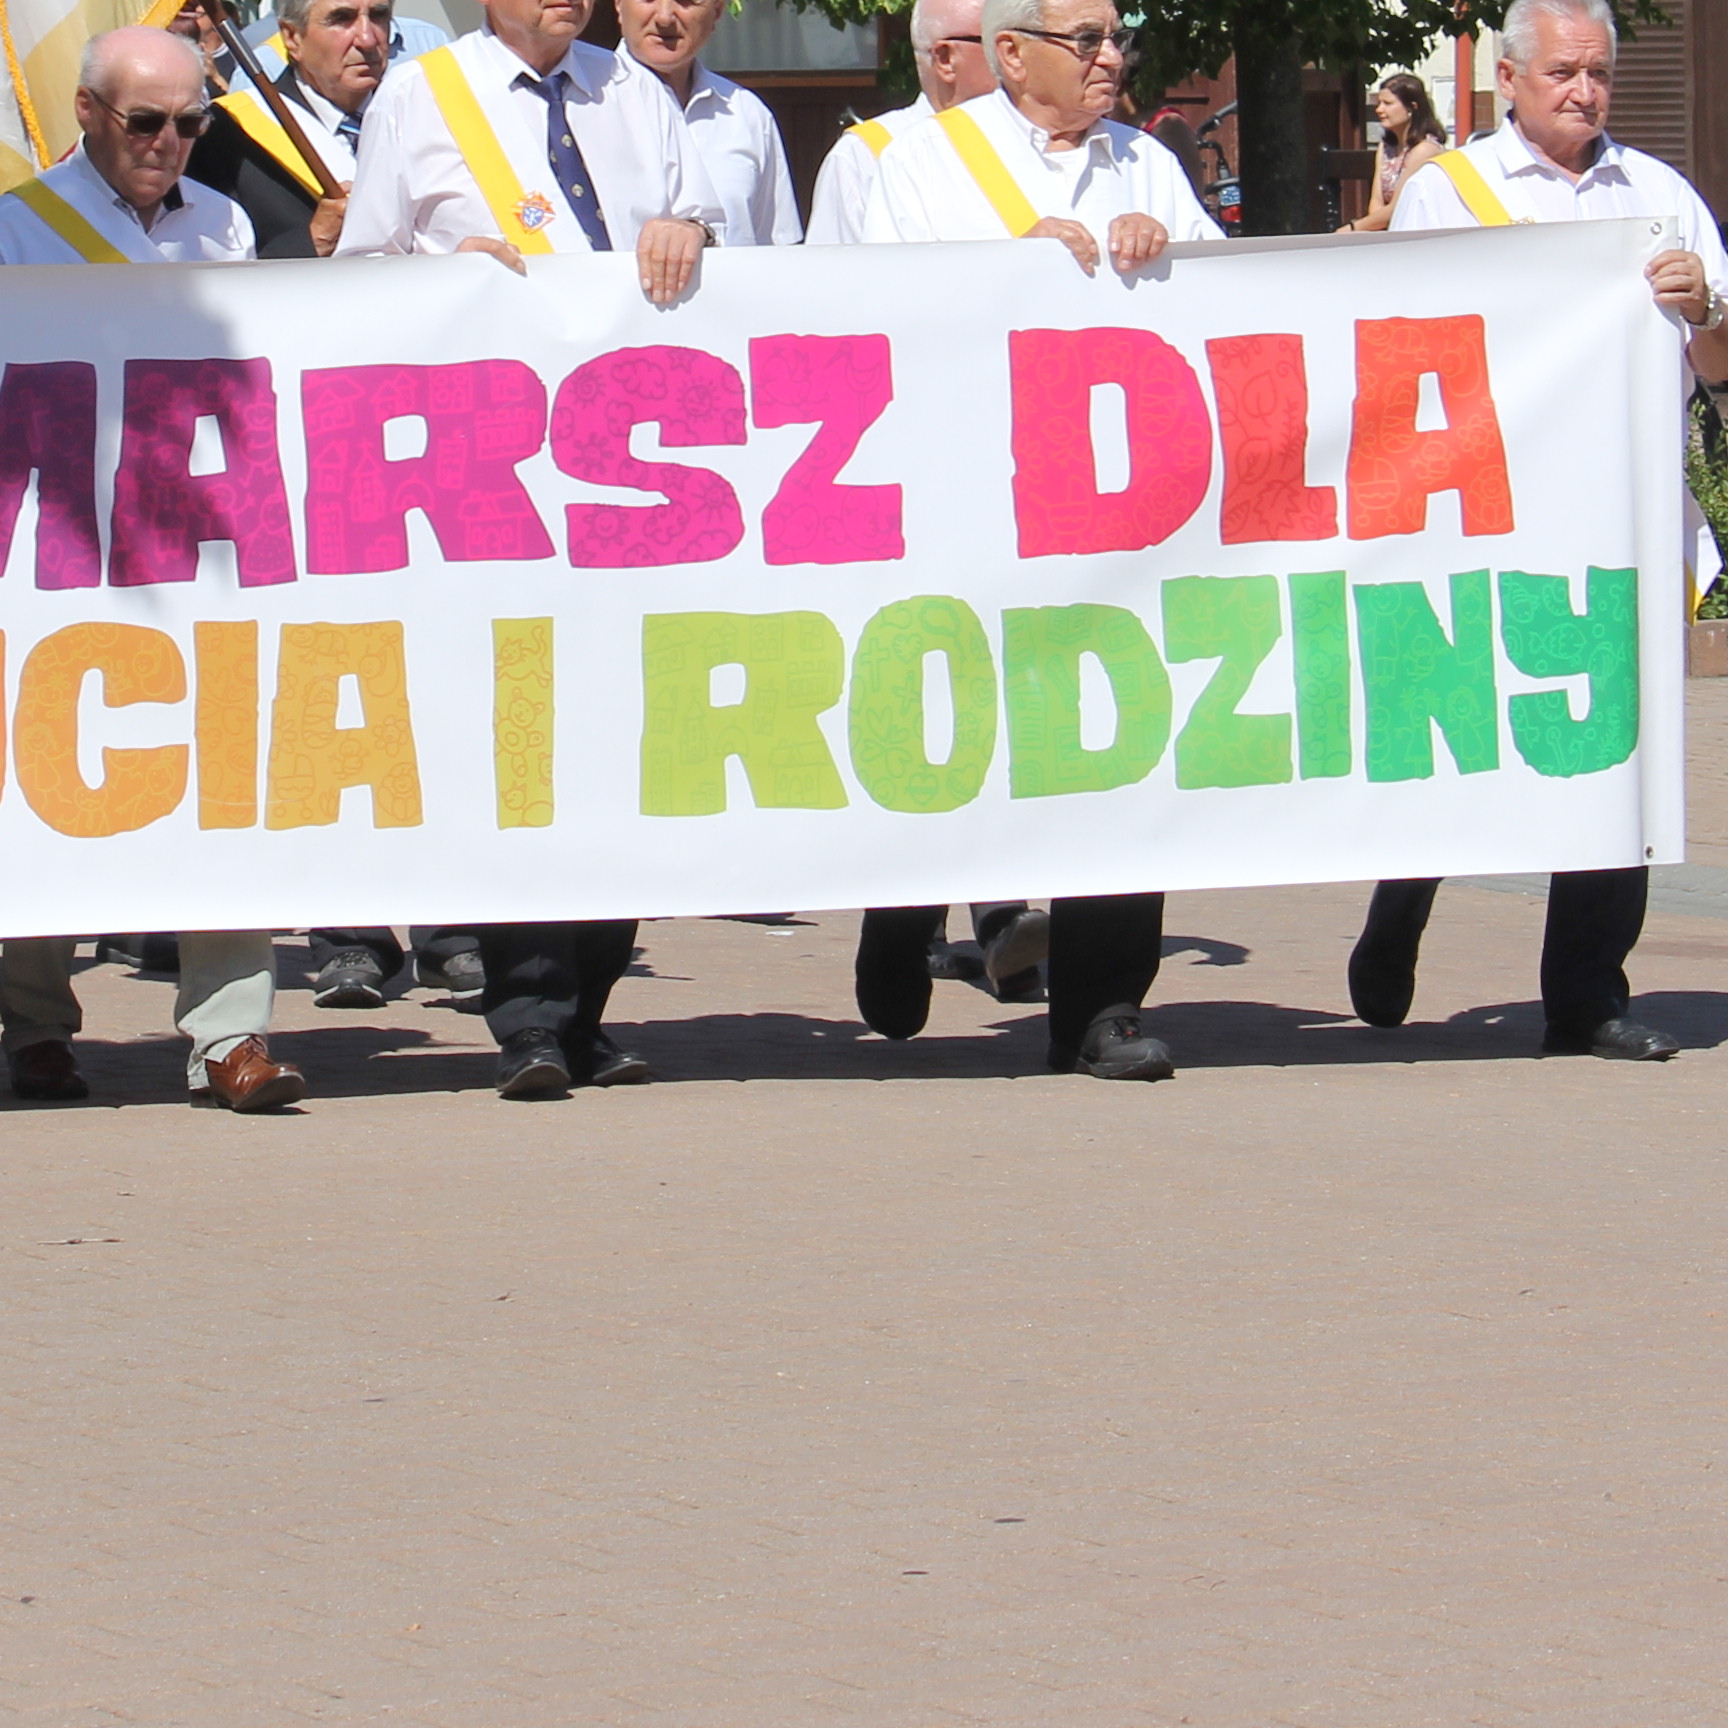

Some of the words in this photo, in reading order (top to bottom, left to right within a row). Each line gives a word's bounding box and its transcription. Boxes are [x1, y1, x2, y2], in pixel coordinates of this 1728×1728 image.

[1008, 314, 1515, 559] DLA
[493, 617, 554, 829] I
[641, 567, 1639, 815] RODZINY
